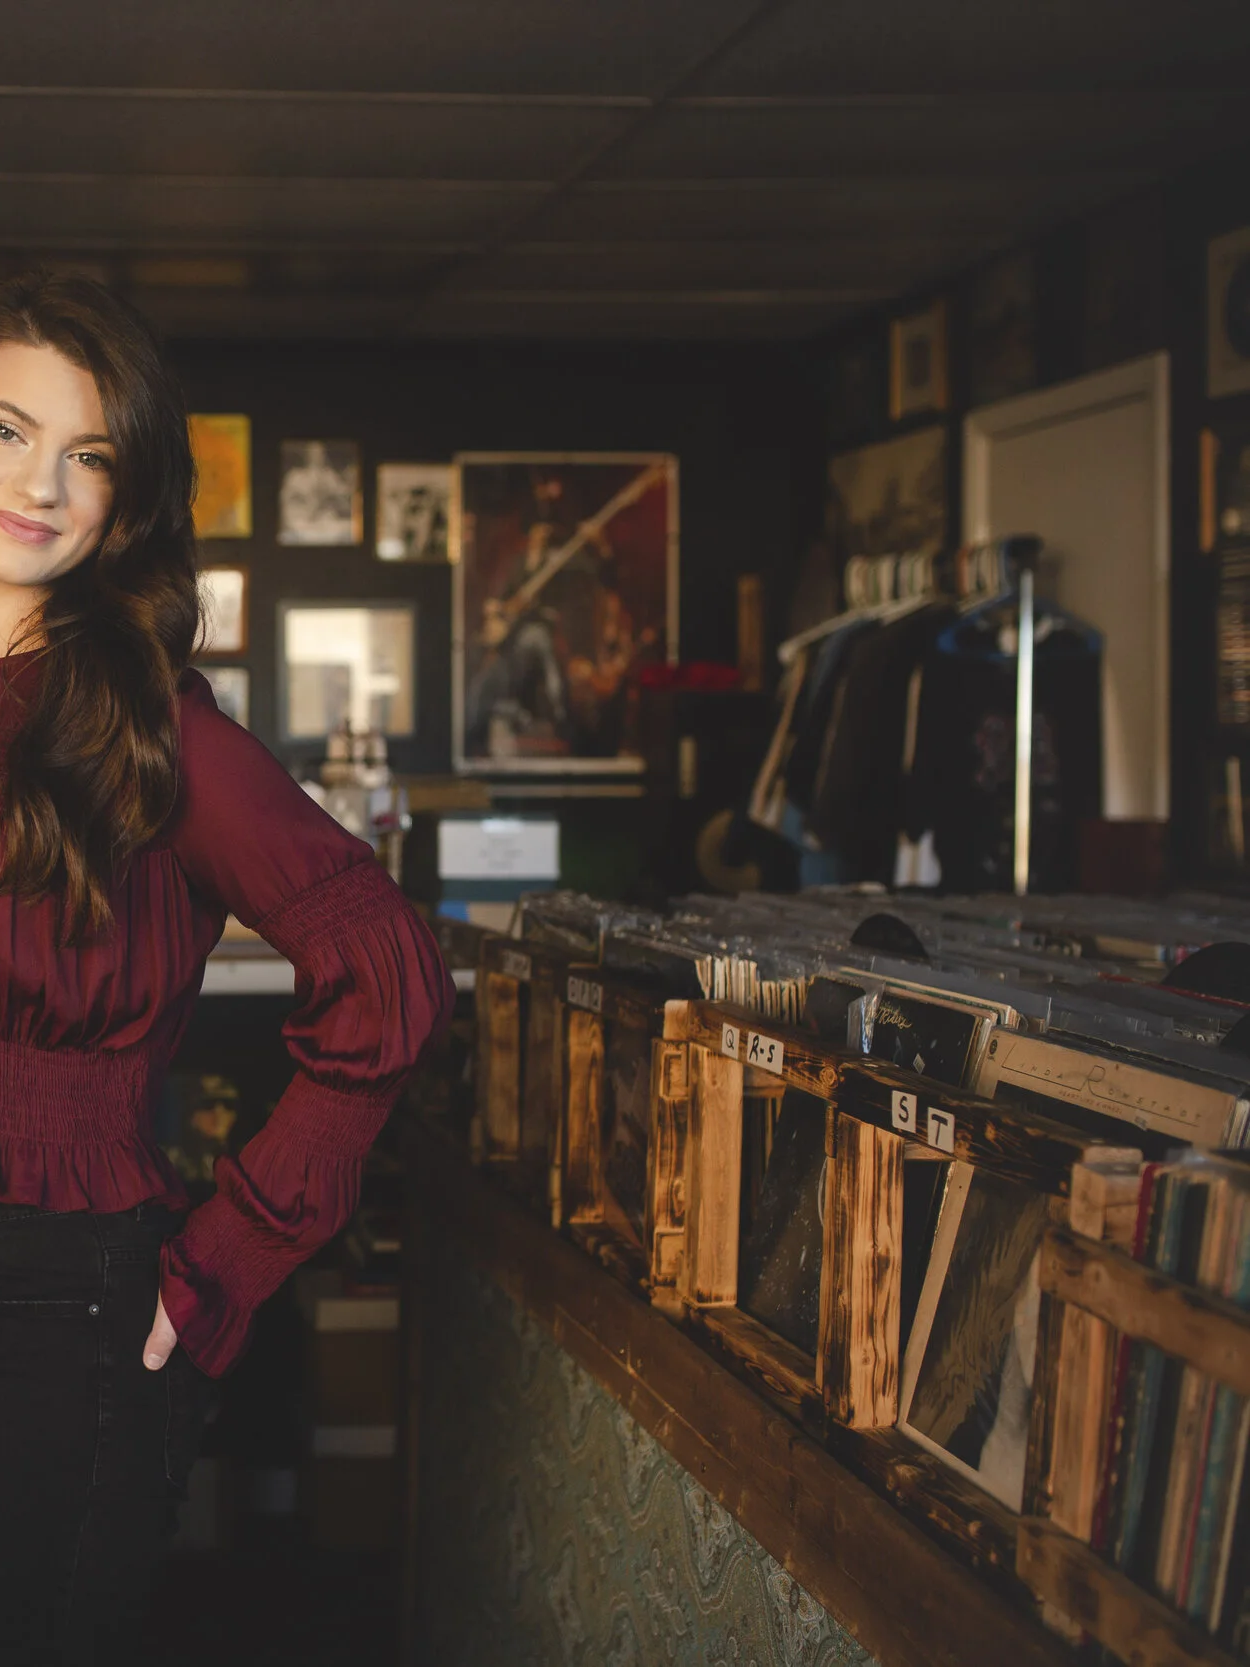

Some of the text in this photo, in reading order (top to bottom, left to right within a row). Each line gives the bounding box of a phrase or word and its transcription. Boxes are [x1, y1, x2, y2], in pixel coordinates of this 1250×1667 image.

[725, 1028, 776, 1063] Q R-S
[898, 1095, 948, 1145] S T
